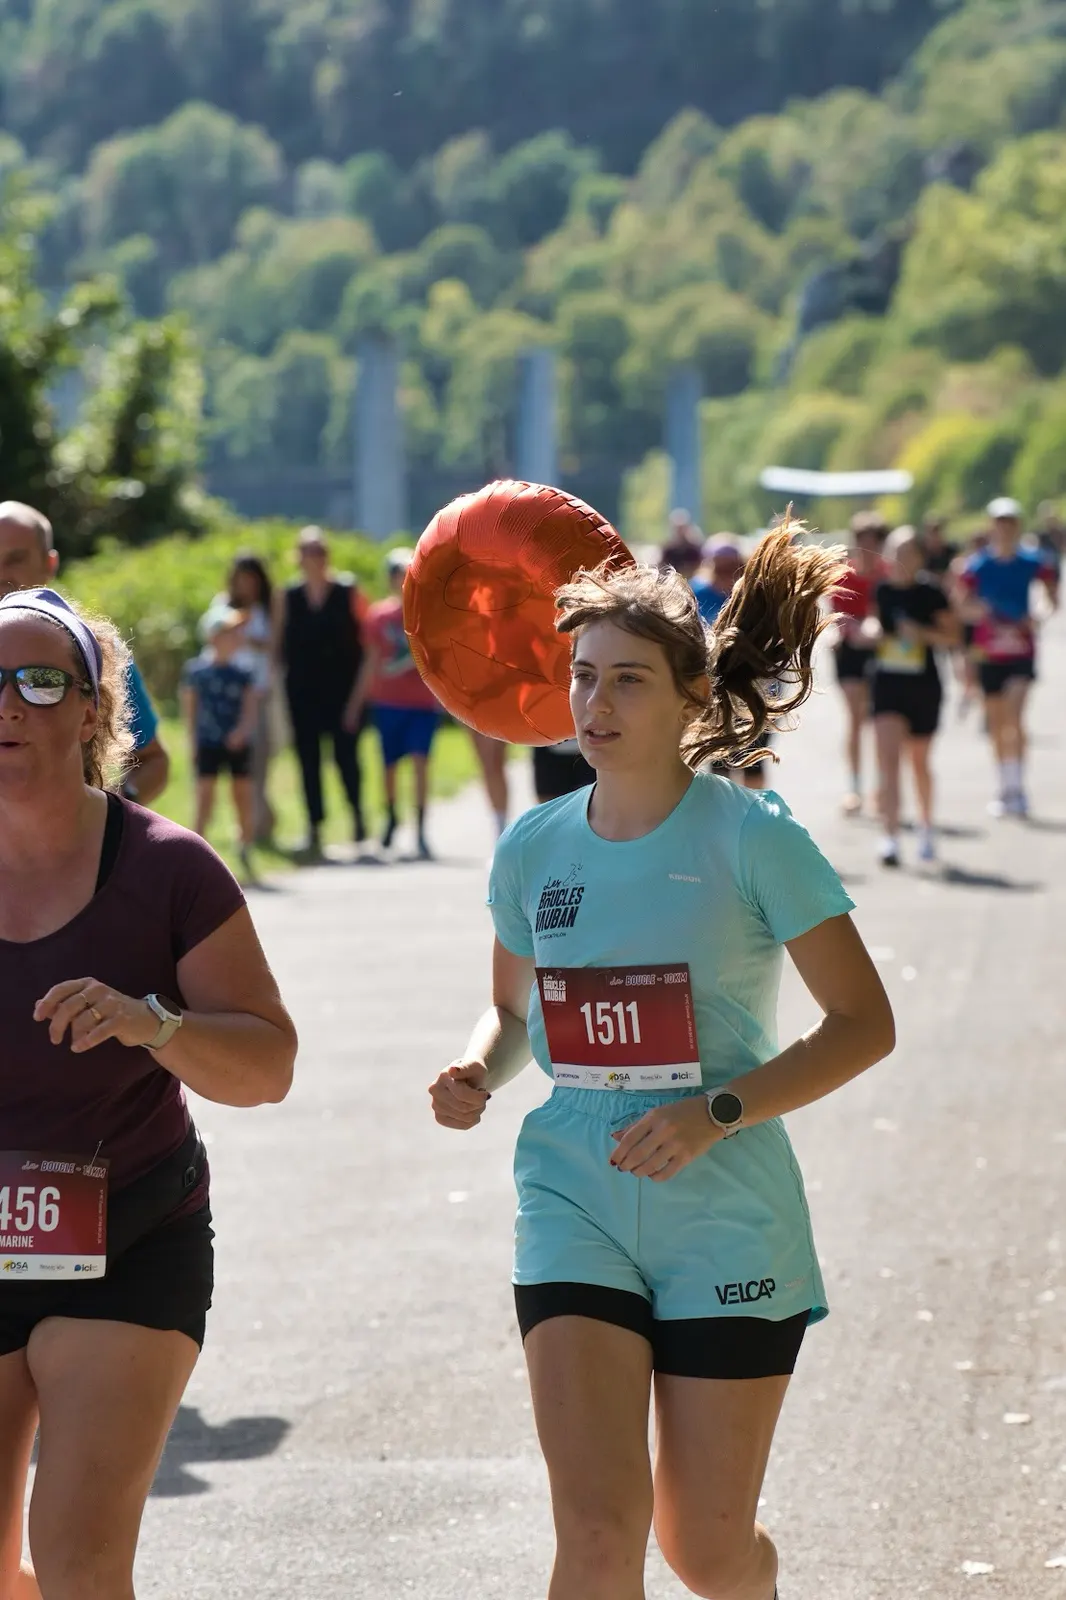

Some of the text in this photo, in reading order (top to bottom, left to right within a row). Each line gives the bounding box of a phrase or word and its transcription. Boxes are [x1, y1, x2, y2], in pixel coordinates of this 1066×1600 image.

[538, 886, 585, 910] BOUCLES
[535, 906, 580, 933] VAUBAN
[625, 974, 656, 986] BOUCLE
[663, 972, 688, 984] 10KM
[544, 990, 567, 1002] VAUBAN
[580, 1001, 641, 1045] 1511
[614, 1073, 630, 1081] DSA
[41, 1161, 75, 1174] BOUCLE
[11, 1262, 28, 1270] DSA
[714, 1278, 776, 1305] VELCAP
